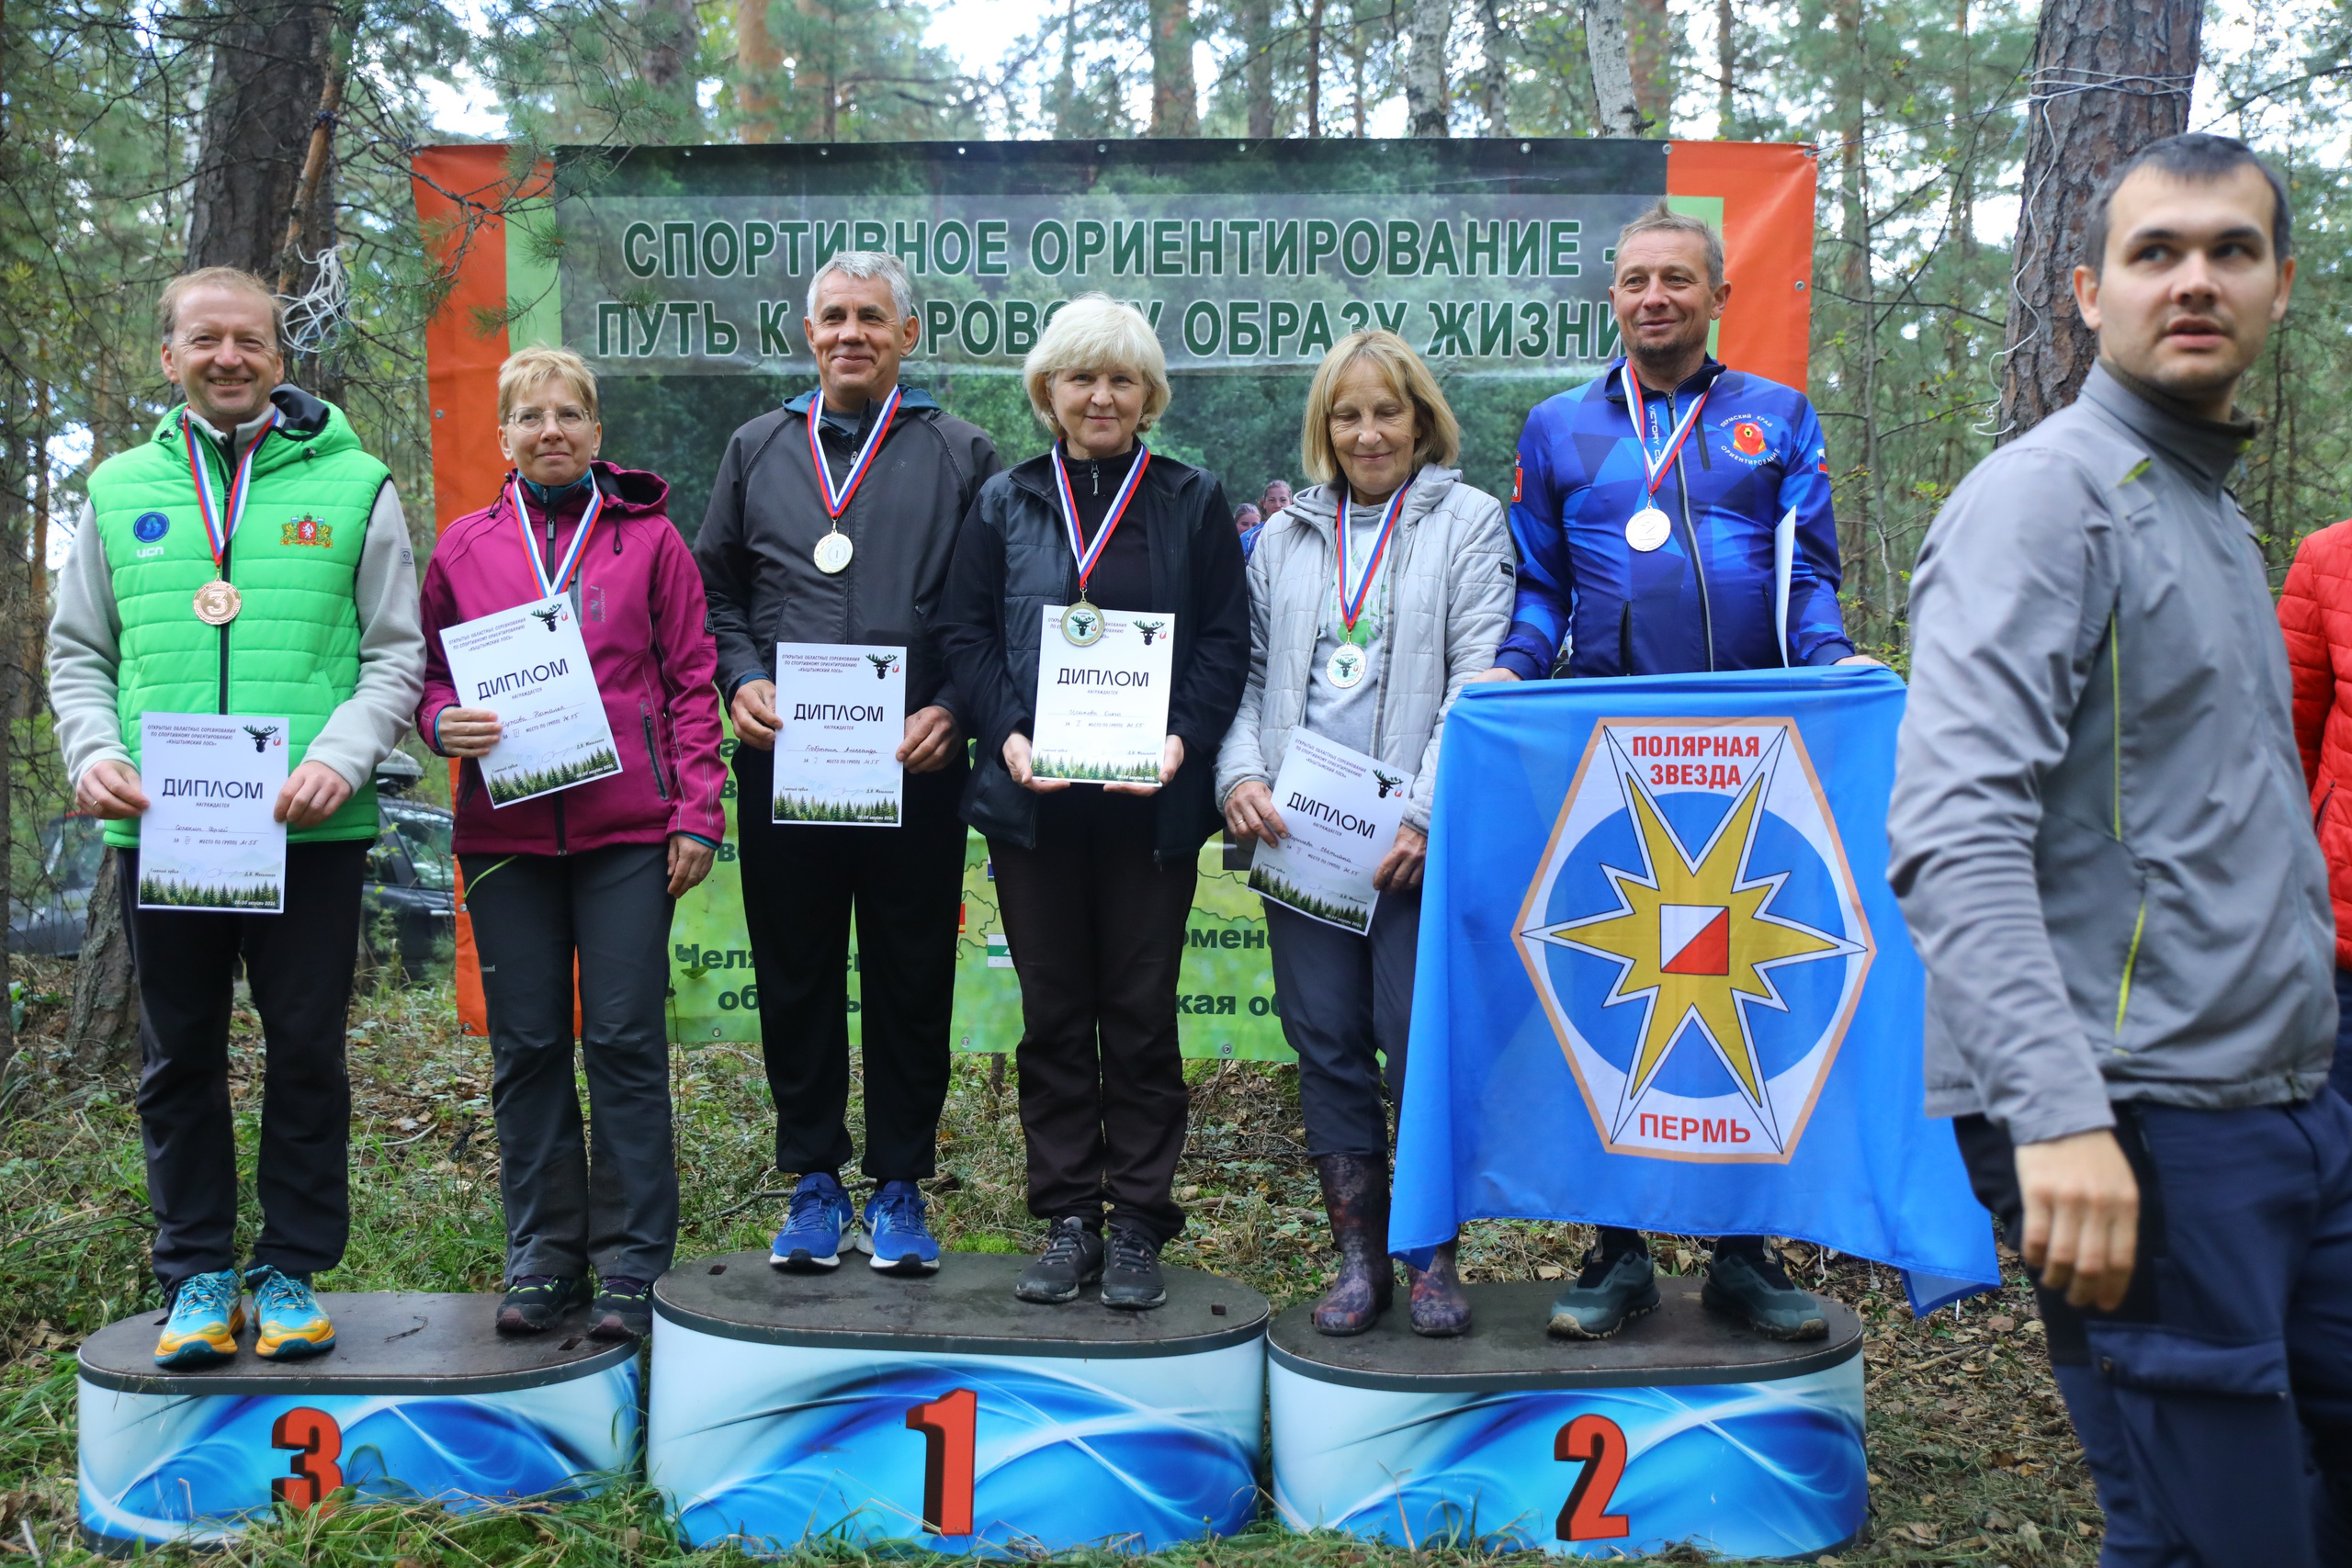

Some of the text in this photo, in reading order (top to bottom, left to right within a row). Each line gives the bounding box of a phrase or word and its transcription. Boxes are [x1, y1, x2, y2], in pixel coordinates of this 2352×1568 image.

[623, 220, 1009, 276] СПОРТИВНОЕ
[1031, 220, 1581, 276] ОРИЕНТИРОВАНИЕ
[597, 300, 739, 356] ПУТЬ
[759, 300, 792, 356] К
[1427, 301, 1624, 357] ЖИЗНИ
[1649, 404, 1659, 446] VICTORY
[1720, 413, 1773, 428] ПЕРМСКИЙ КРАЙ
[1721, 445, 1781, 466] ОРИЕНТИРОВАНИЕ
[207, 591, 229, 615] 3
[494, 617, 526, 631] СОРЕВНОВАНИЯ
[477, 658, 569, 701] ДИПЛОМ
[1057, 668, 1148, 687] ДИПЛОМ
[511, 686, 543, 700] НАГРАЖДАЕТСЯ
[794, 703, 883, 722] ДИПЛОМ
[1632, 735, 1759, 758] ПОЛЯРНАЯ
[162, 778, 263, 799] ДИПЛОМ
[1650, 763, 1742, 789] ЗВЕЗДА
[1286, 791, 1375, 840] ДИПЛОМ
[1639, 1112, 1751, 1144] ПЕРМЬ
[270, 1405, 342, 1516] 3
[906, 1388, 978, 1537] 1
[1554, 1413, 1630, 1542] 2
